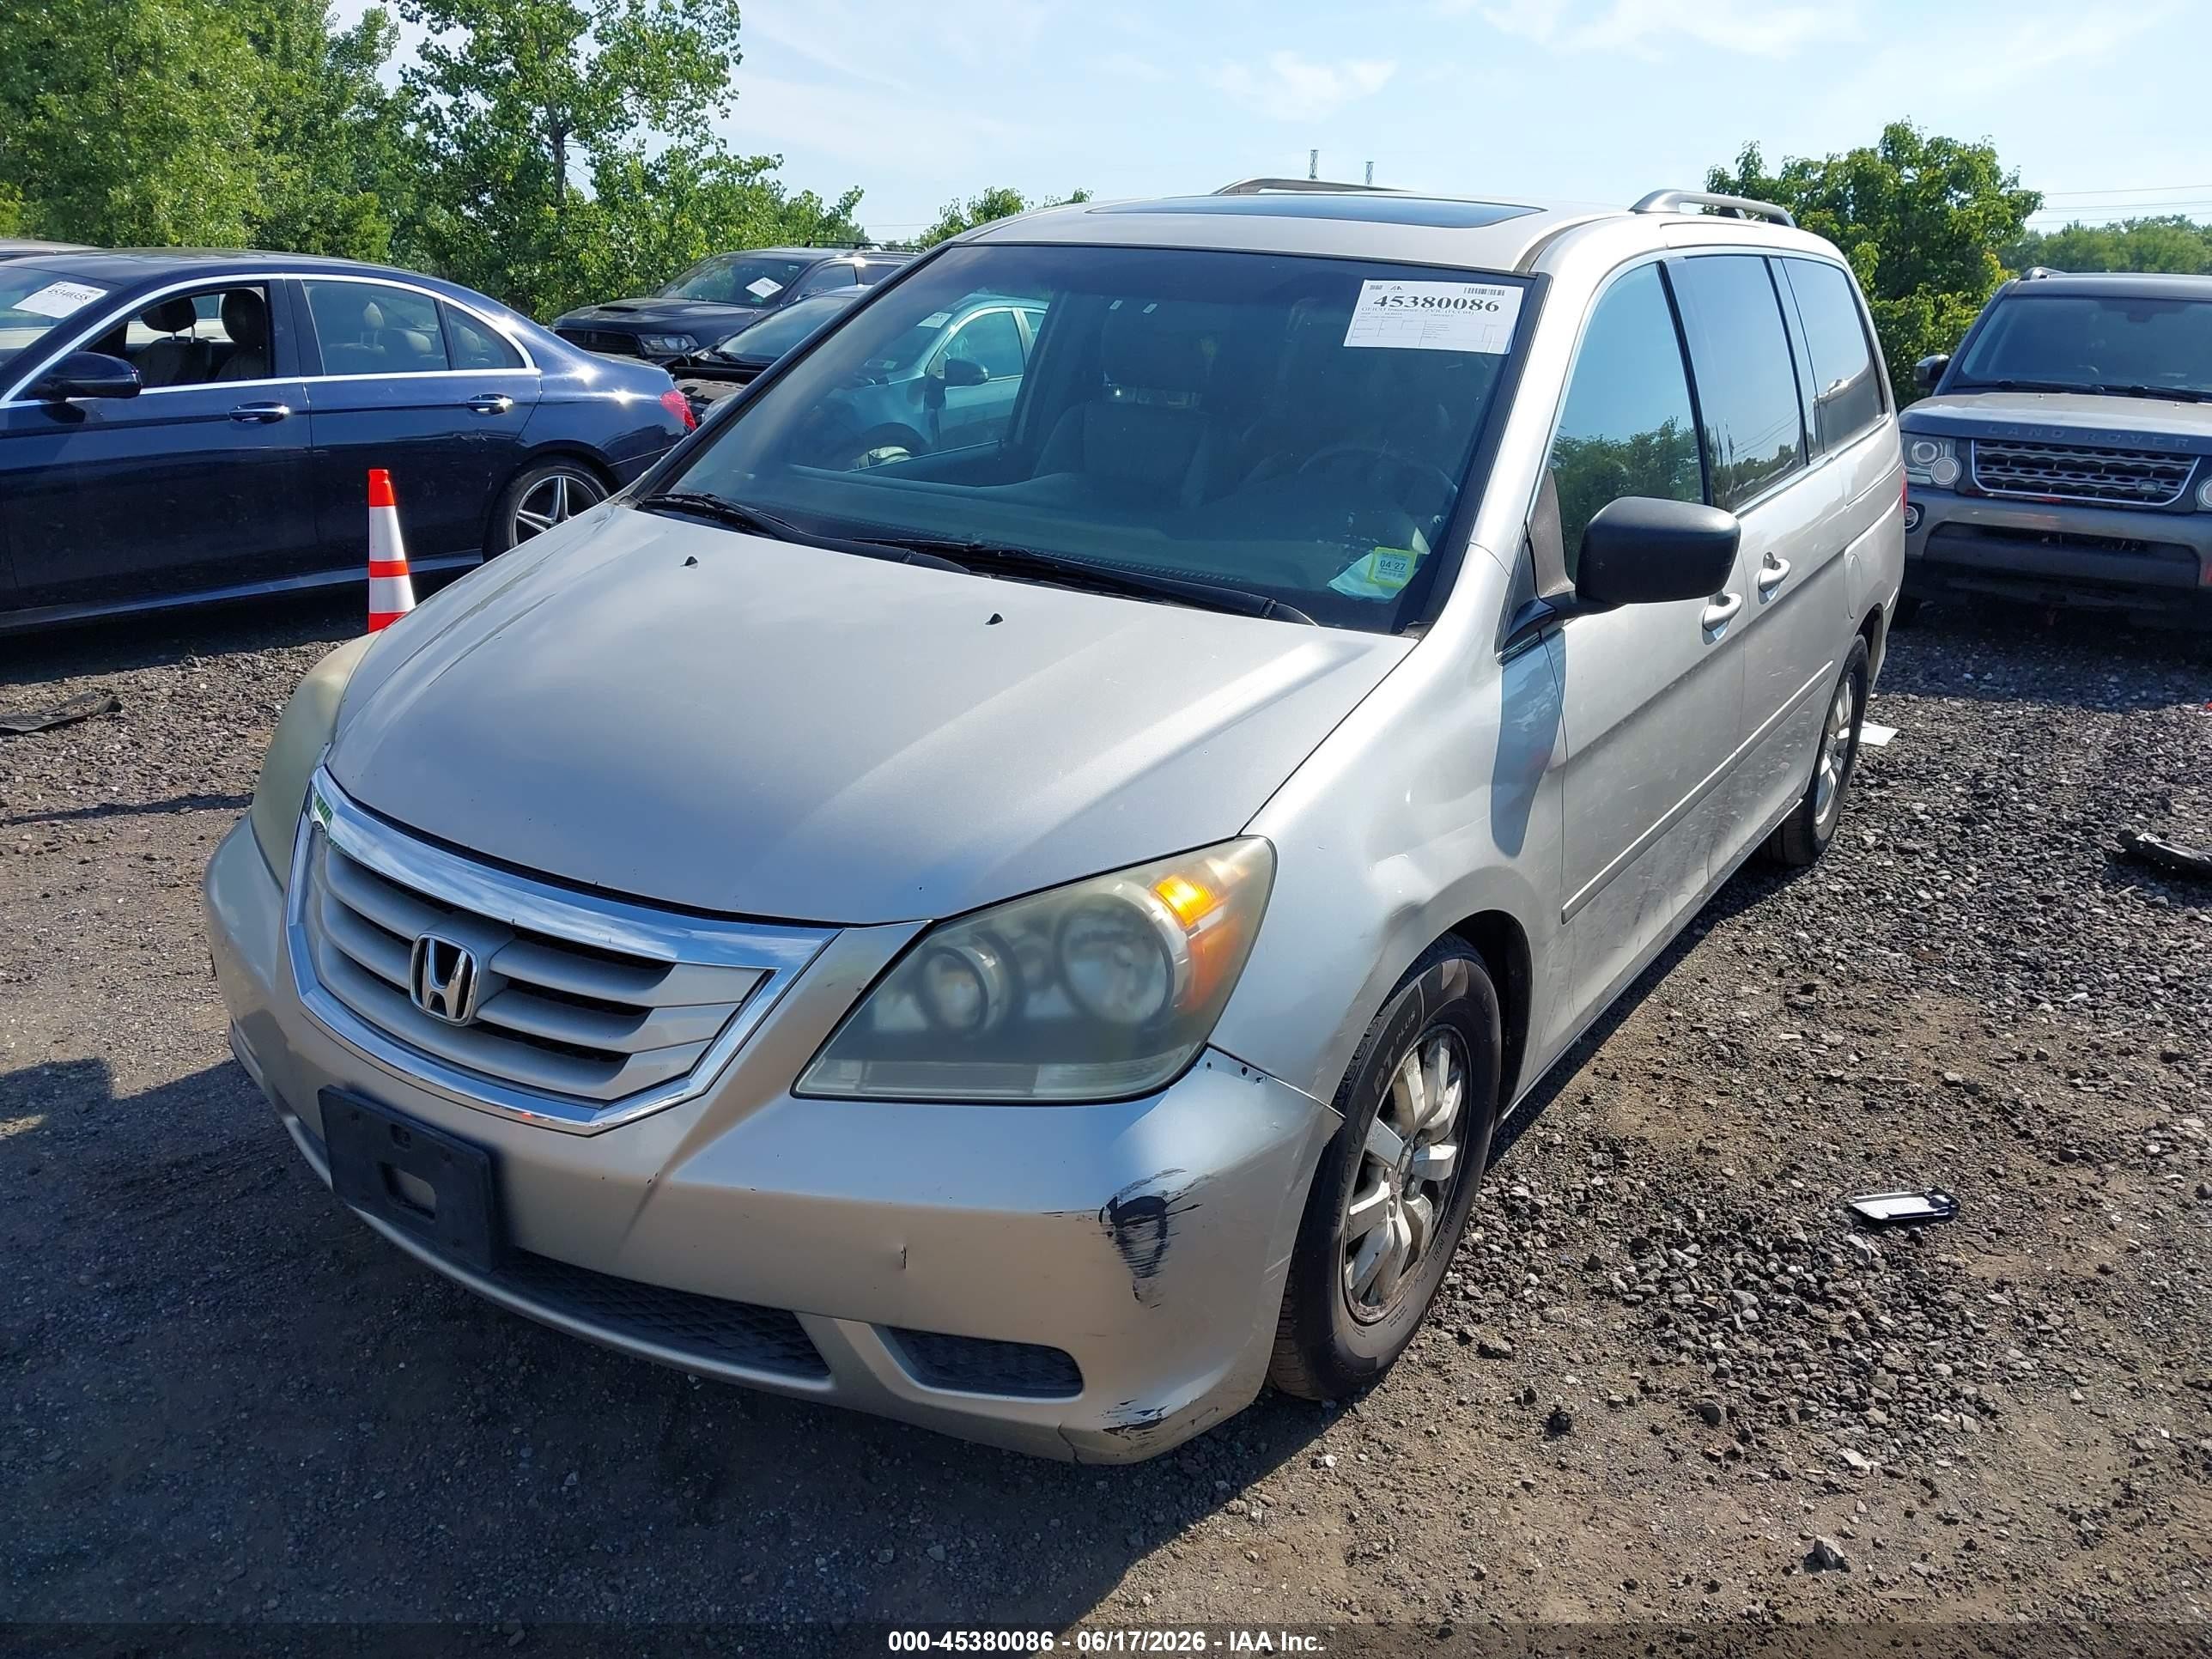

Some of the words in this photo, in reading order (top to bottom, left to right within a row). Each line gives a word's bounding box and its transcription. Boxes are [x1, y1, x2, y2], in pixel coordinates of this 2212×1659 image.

[1373, 295, 1501, 313] 45380086
[1986, 425, 2067, 440] LAND
[2084, 432, 2191, 448] ROVER
